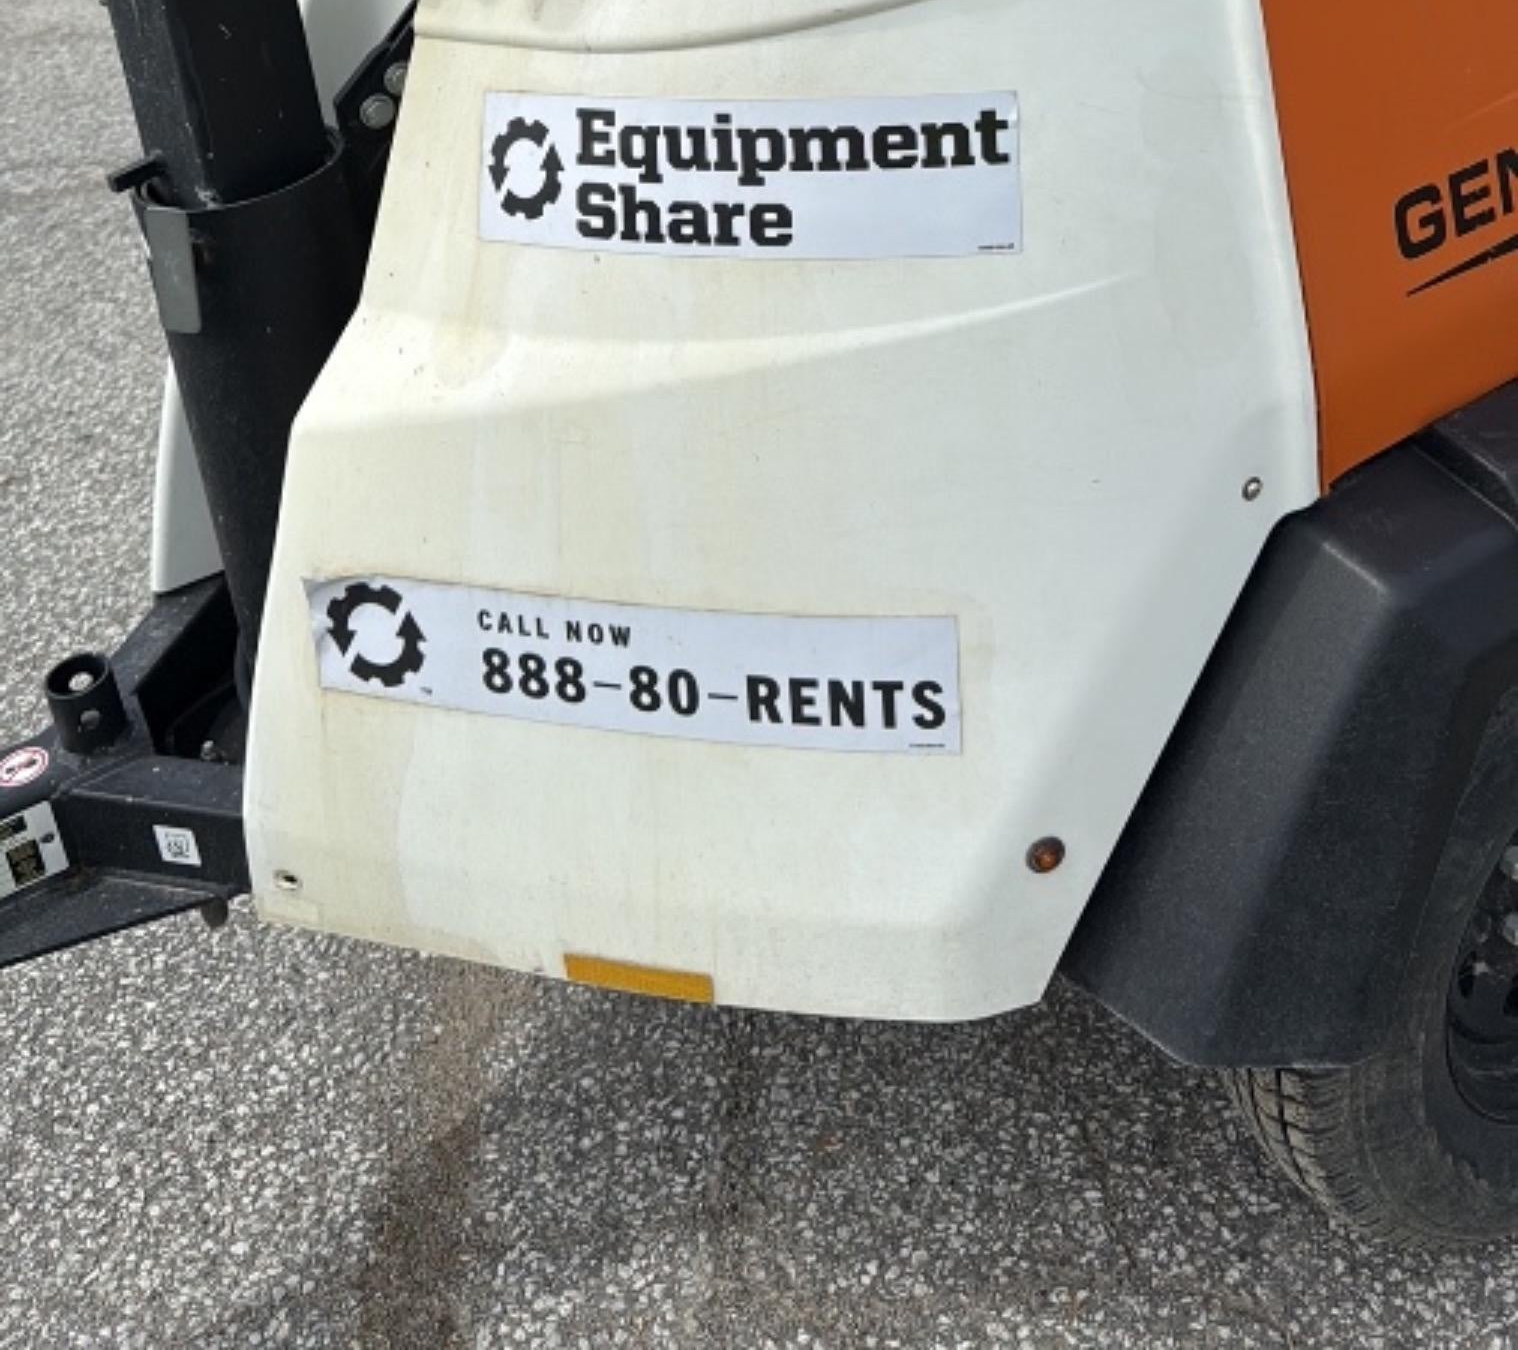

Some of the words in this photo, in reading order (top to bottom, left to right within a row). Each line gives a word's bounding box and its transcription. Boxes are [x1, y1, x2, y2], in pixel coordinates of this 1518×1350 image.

[576, 108, 1010, 186] Equipment
[576, 182, 793, 247] Share
[478, 610, 549, 639] CALL
[566, 620, 632, 647] NOW
